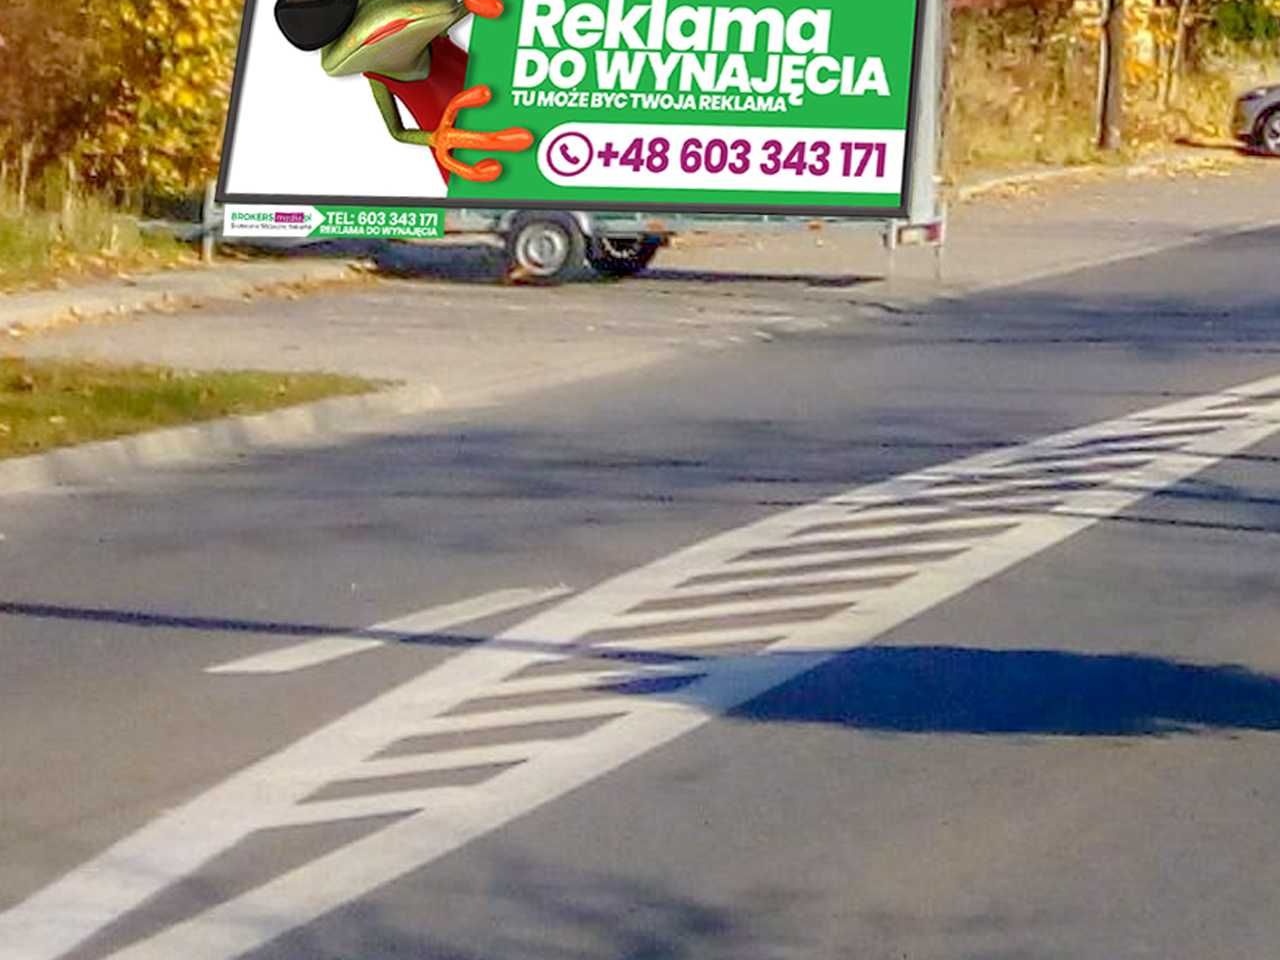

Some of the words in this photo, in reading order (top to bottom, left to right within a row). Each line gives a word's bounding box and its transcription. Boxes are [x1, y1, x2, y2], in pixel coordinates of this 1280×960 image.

[511, 48, 587, 90] DO
[594, 49, 891, 106] WYNAJĘCIA
[511, 90, 536, 107] TU
[537, 87, 590, 108] MOŻE
[629, 92, 697, 110] TWOJA
[698, 94, 788, 113] REKLAMA
[597, 136, 671, 174] +48
[679, 137, 751, 175] 603
[759, 139, 831, 177] 343
[839, 141, 887, 178] 171
[320, 225, 364, 235] REKLAMA
[366, 226, 380, 235] DO
[358, 211, 386, 226] 603
[389, 212, 416, 226] 343
[419, 213, 438, 227] 171
